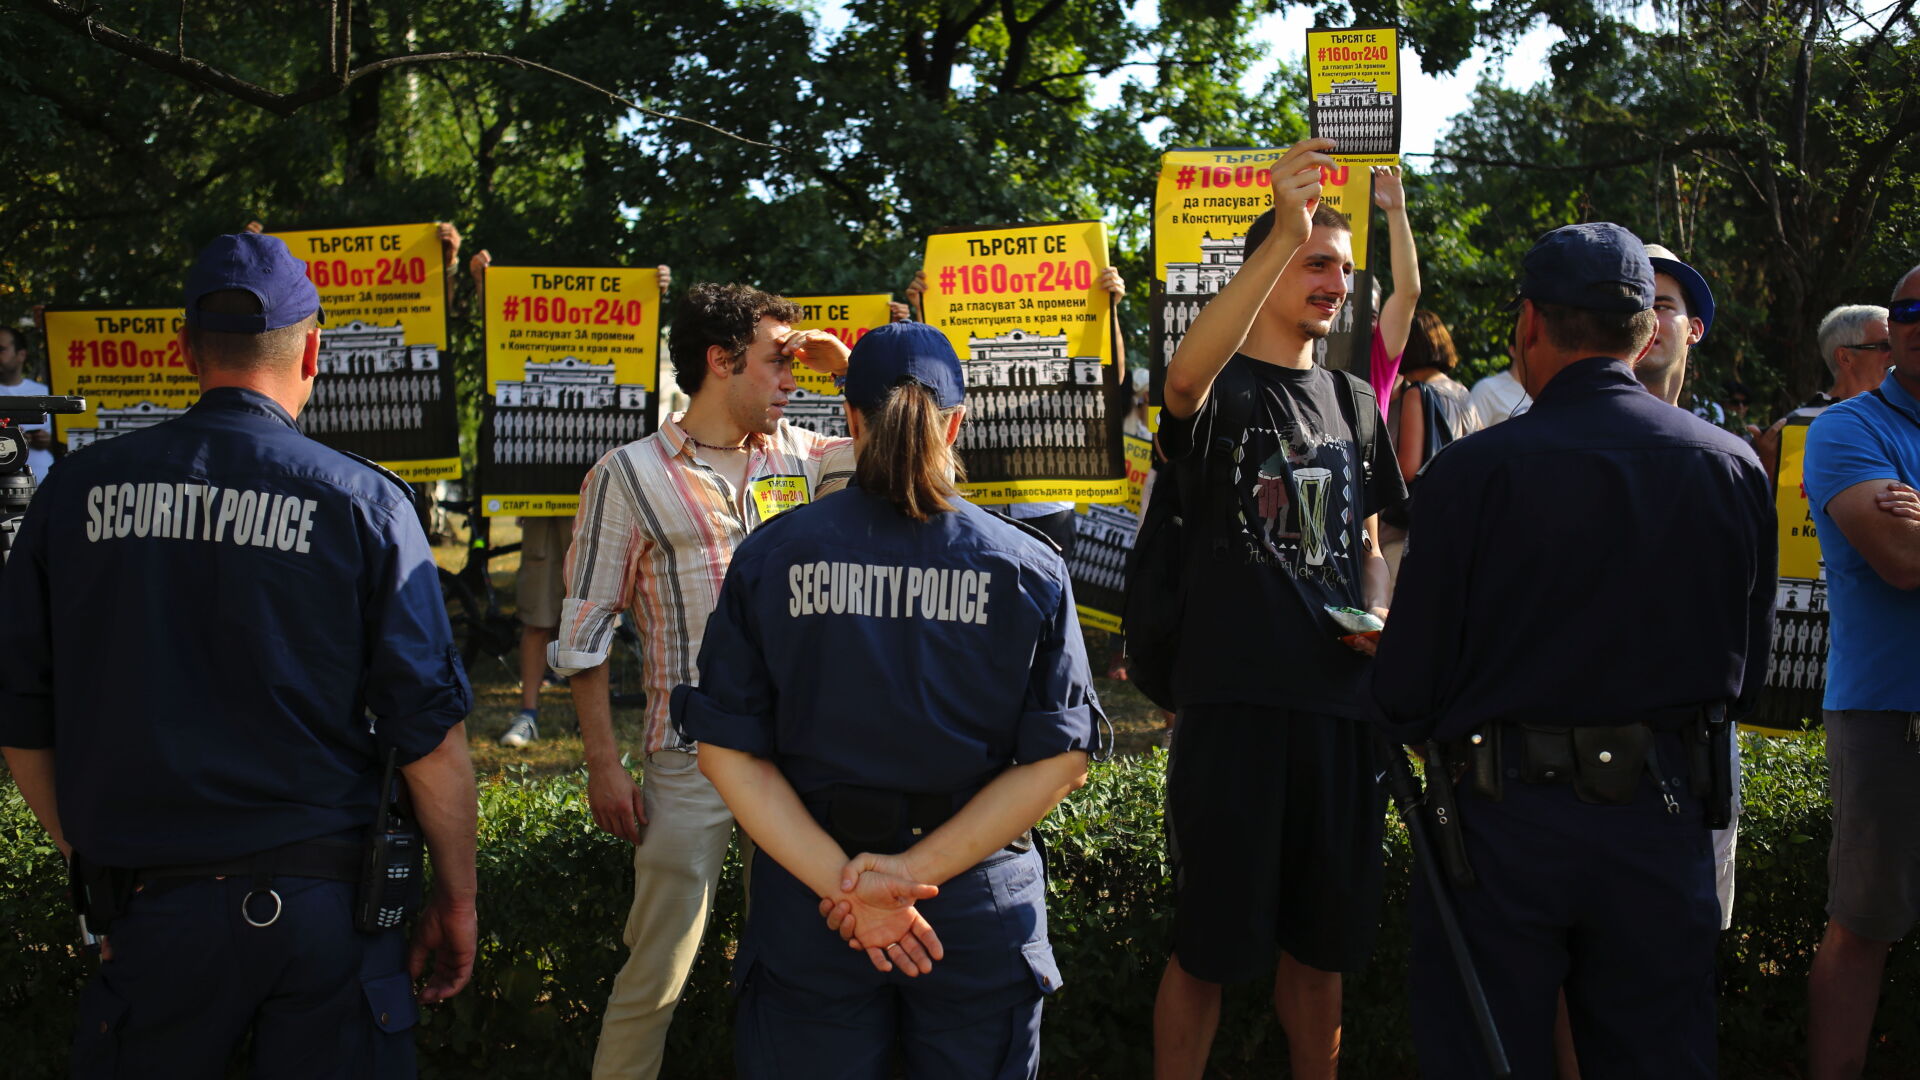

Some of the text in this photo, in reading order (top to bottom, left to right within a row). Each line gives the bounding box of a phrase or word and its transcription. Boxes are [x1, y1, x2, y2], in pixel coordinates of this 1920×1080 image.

[1331, 34, 1377, 44] ТЪРСЯТ СЕ
[1318, 46, 1388, 62] #160от240
[1184, 194, 1273, 210] да гласуват З
[1172, 213, 1260, 226] в Конституция
[308, 235, 401, 254] ТЪРСЯТ СЕ
[967, 235, 1067, 257] ТЪРСЯТ СЕ
[305, 256, 426, 288] 60от240
[939, 260, 1092, 296] #160от240
[531, 273, 621, 292] ТЪРСЯТ СЕ
[319, 291, 421, 304] асуват ЗА промени
[950, 298, 1086, 313] да гласуват ЗА промени
[411, 305, 431, 313] юли
[503, 295, 642, 327] #160от240
[828, 304, 849, 321] СЕ
[95, 317, 187, 334] ТЪРСЯТ С
[950, 316, 1022, 329] Конституцията
[1025, 316, 1031, 324] в
[1034, 315, 1057, 326] края
[1060, 314, 1072, 322] на
[1075, 313, 1097, 323] юли
[509, 329, 635, 344] да гласуват ЗА промени
[68, 340, 186, 369] #160от2
[508, 341, 575, 354] Конституцията
[586, 345, 608, 355] края
[624, 346, 644, 354] юли
[77, 373, 199, 386] да гласуват ЗА пром
[77, 387, 150, 398] Конституцията
[412, 464, 456, 477] реформа!
[991, 490, 1002, 498] на
[1005, 487, 1073, 499] Правосъдната
[1075, 486, 1122, 499] реформа!
[502, 501, 530, 510] СТАРТ
[545, 501, 580, 511] Правос
[86, 482, 318, 554] SECURITY POLICE
[1791, 527, 1799, 536] в
[789, 561, 992, 625] SECURITY POLICE
